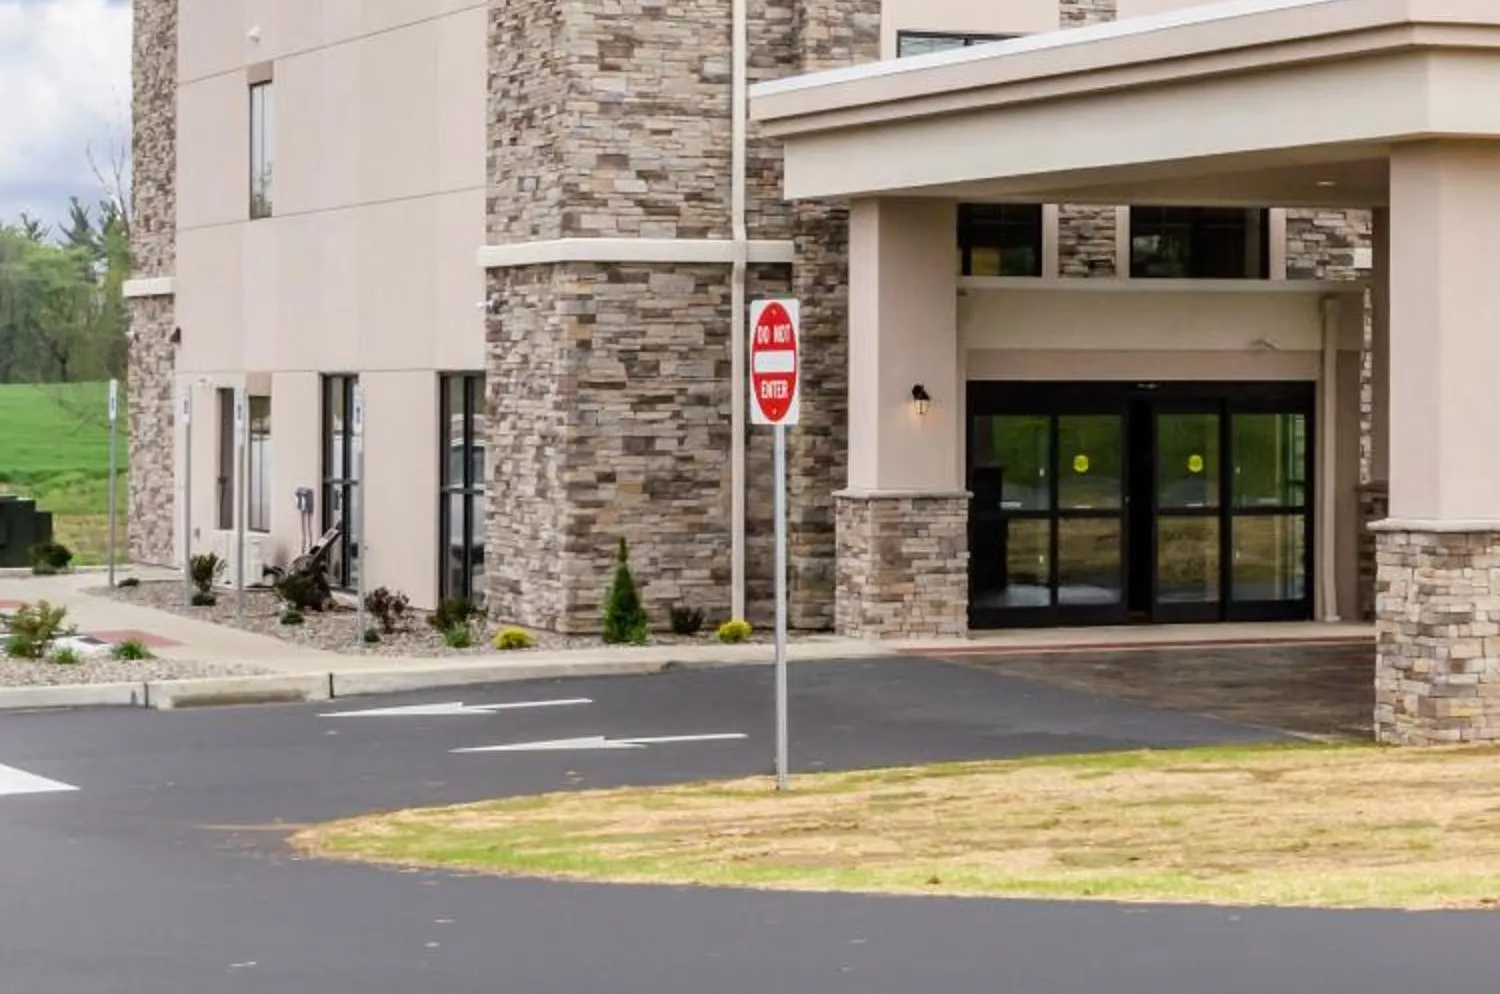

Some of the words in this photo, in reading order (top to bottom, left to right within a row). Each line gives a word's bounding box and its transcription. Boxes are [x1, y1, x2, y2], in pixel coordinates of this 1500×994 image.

[757, 324, 771, 345] DO
[773, 323, 791, 344] NOT
[761, 379, 789, 399] ENTER
